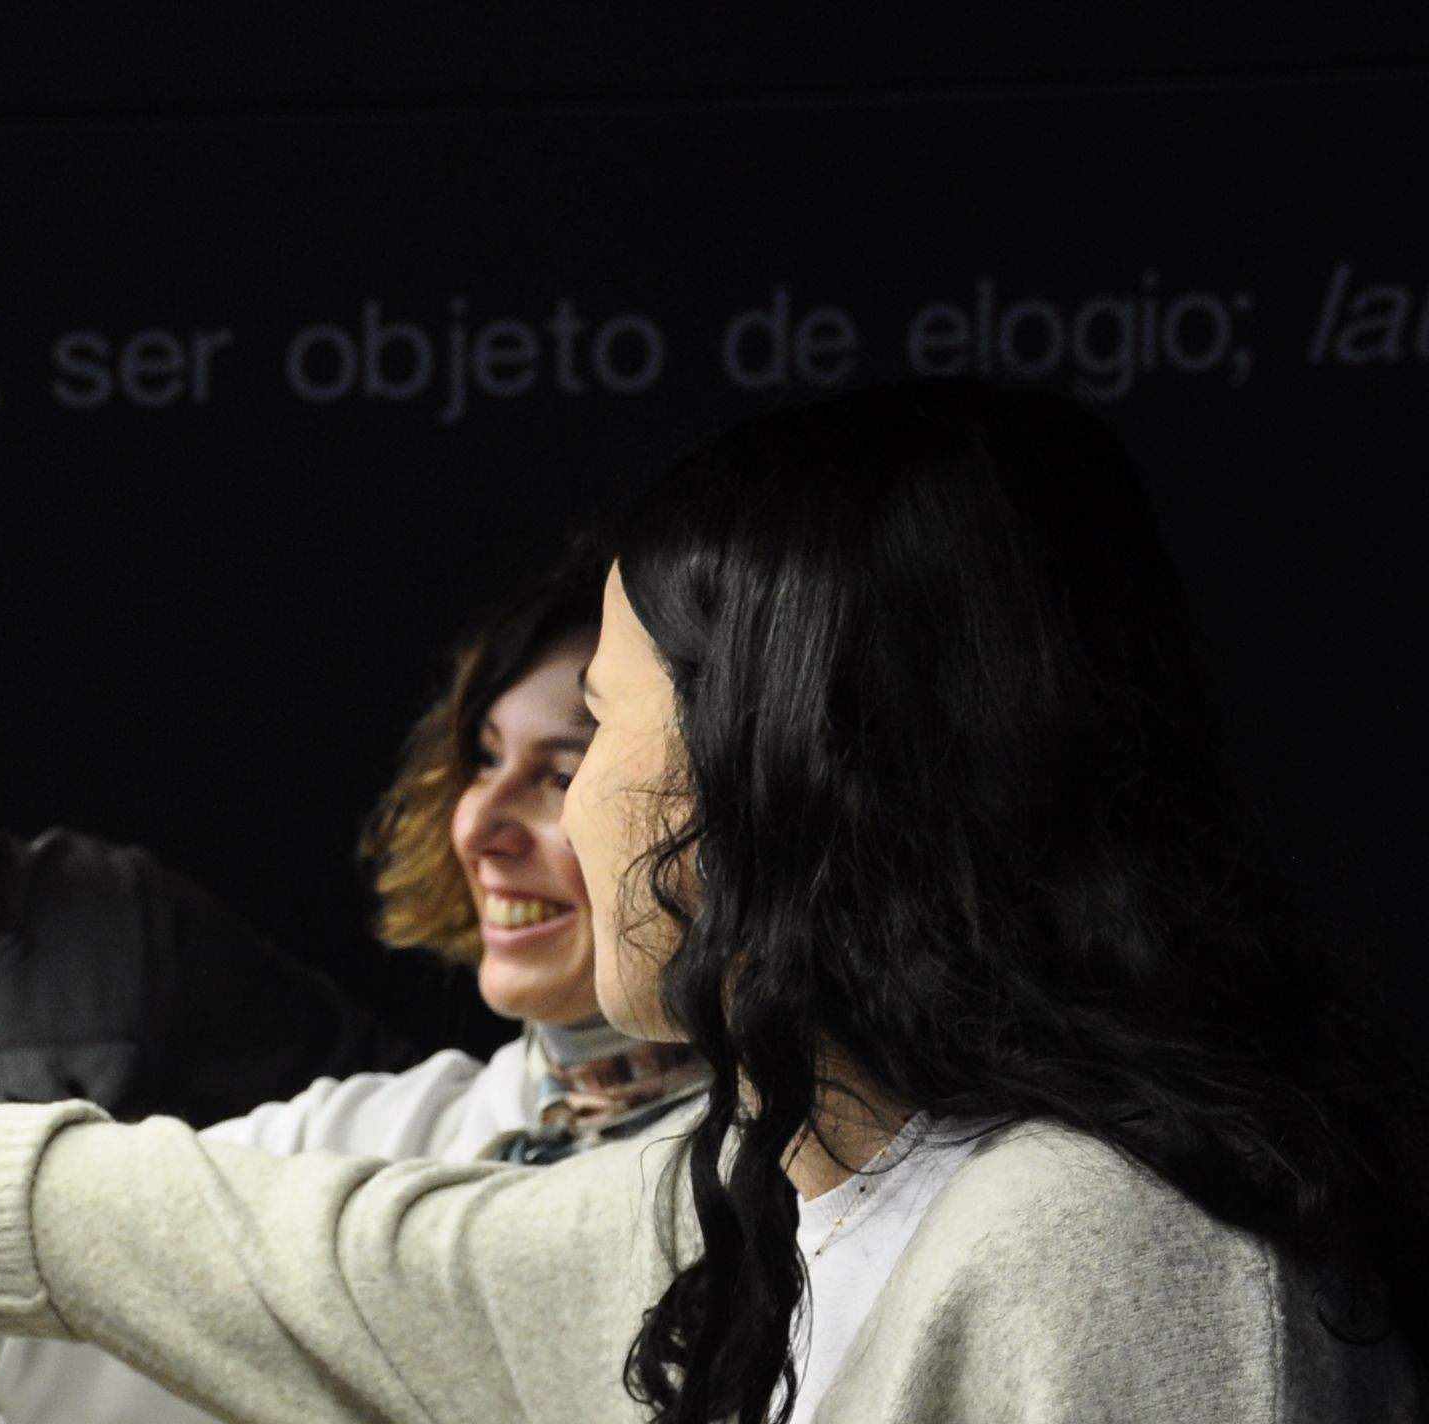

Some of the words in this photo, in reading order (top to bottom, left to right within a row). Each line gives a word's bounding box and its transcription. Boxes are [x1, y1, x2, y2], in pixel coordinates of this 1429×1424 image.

[48, 325, 234, 408] ser
[283, 296, 667, 424] objeto
[719, 283, 861, 392] de
[903, 267, 1256, 402] elogio;
